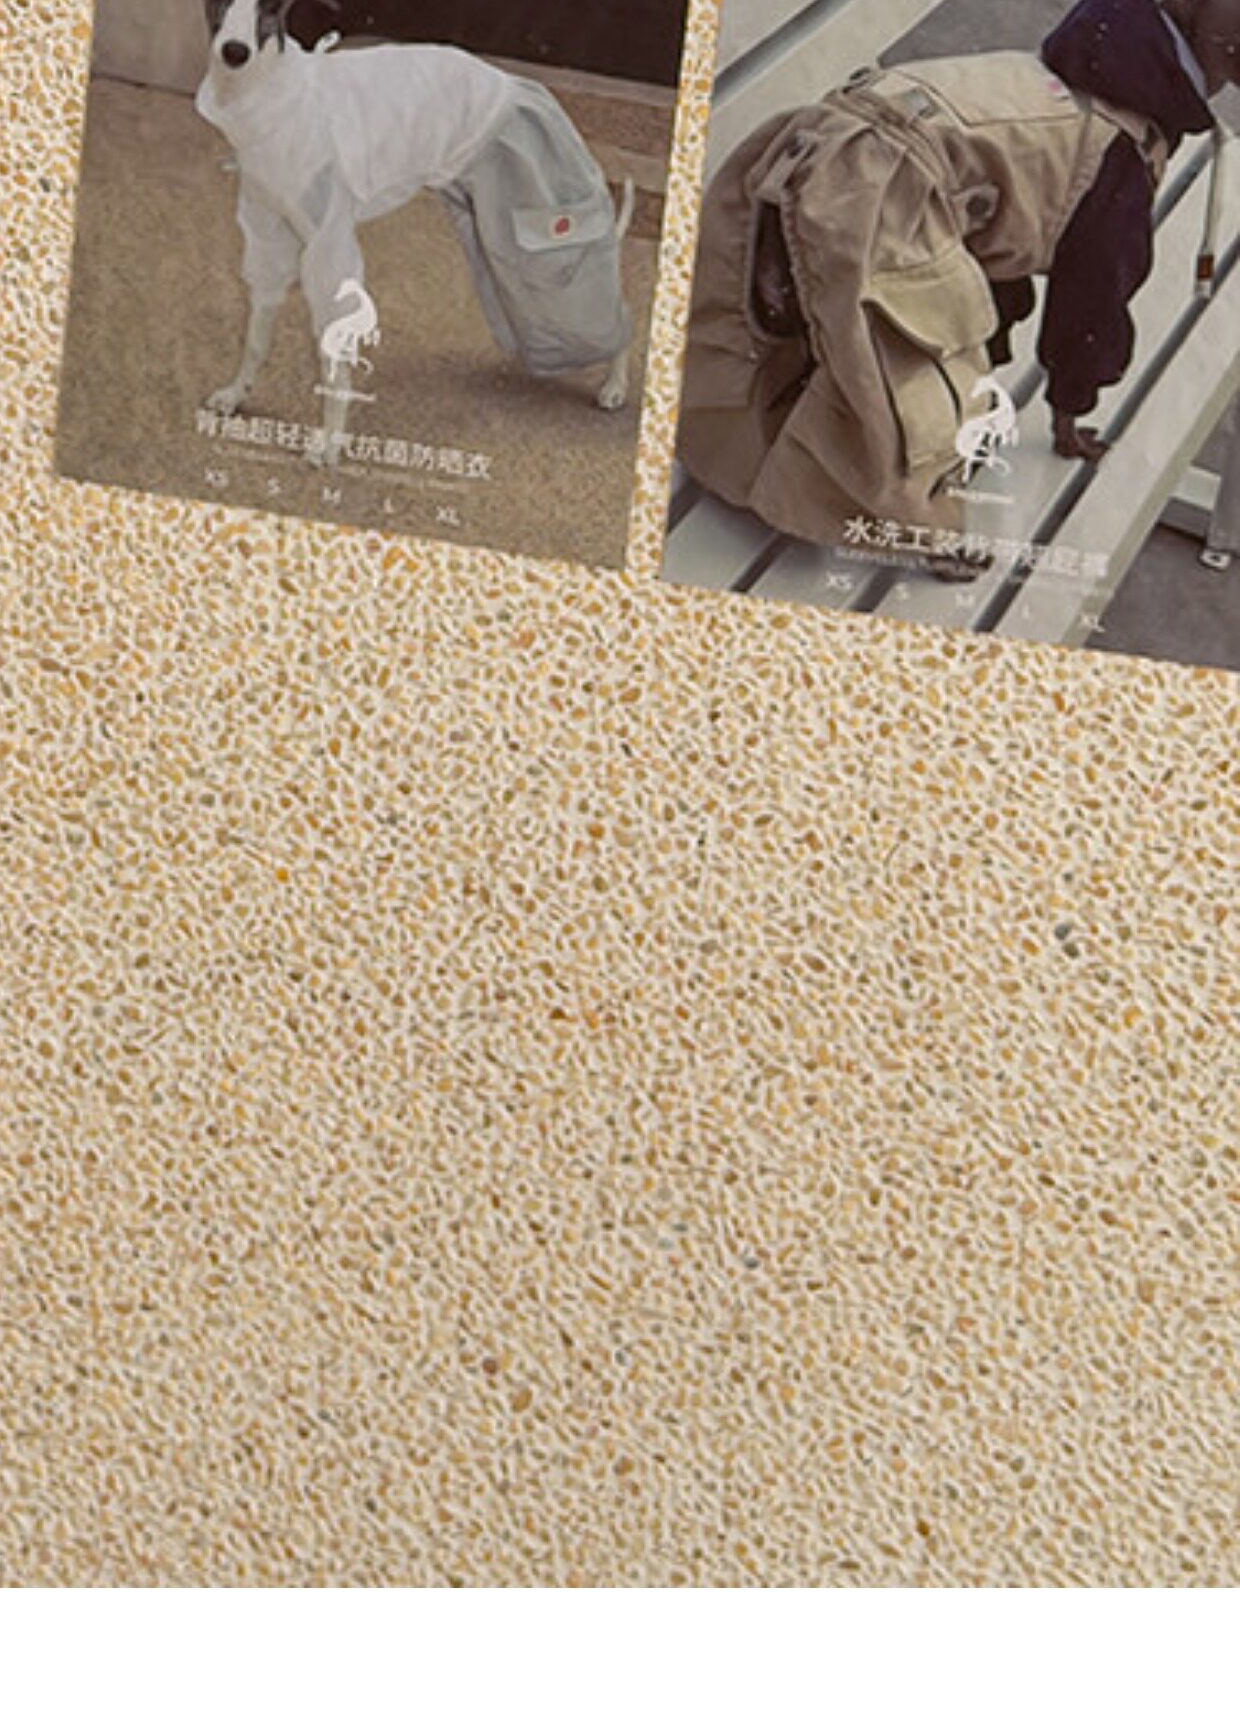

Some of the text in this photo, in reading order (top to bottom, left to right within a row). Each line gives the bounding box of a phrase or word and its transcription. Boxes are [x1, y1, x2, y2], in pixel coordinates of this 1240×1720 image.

[267, 477, 282, 495] S
[322, 485, 343, 506] M
[382, 496, 396, 514] L
[436, 505, 461, 527] XL
